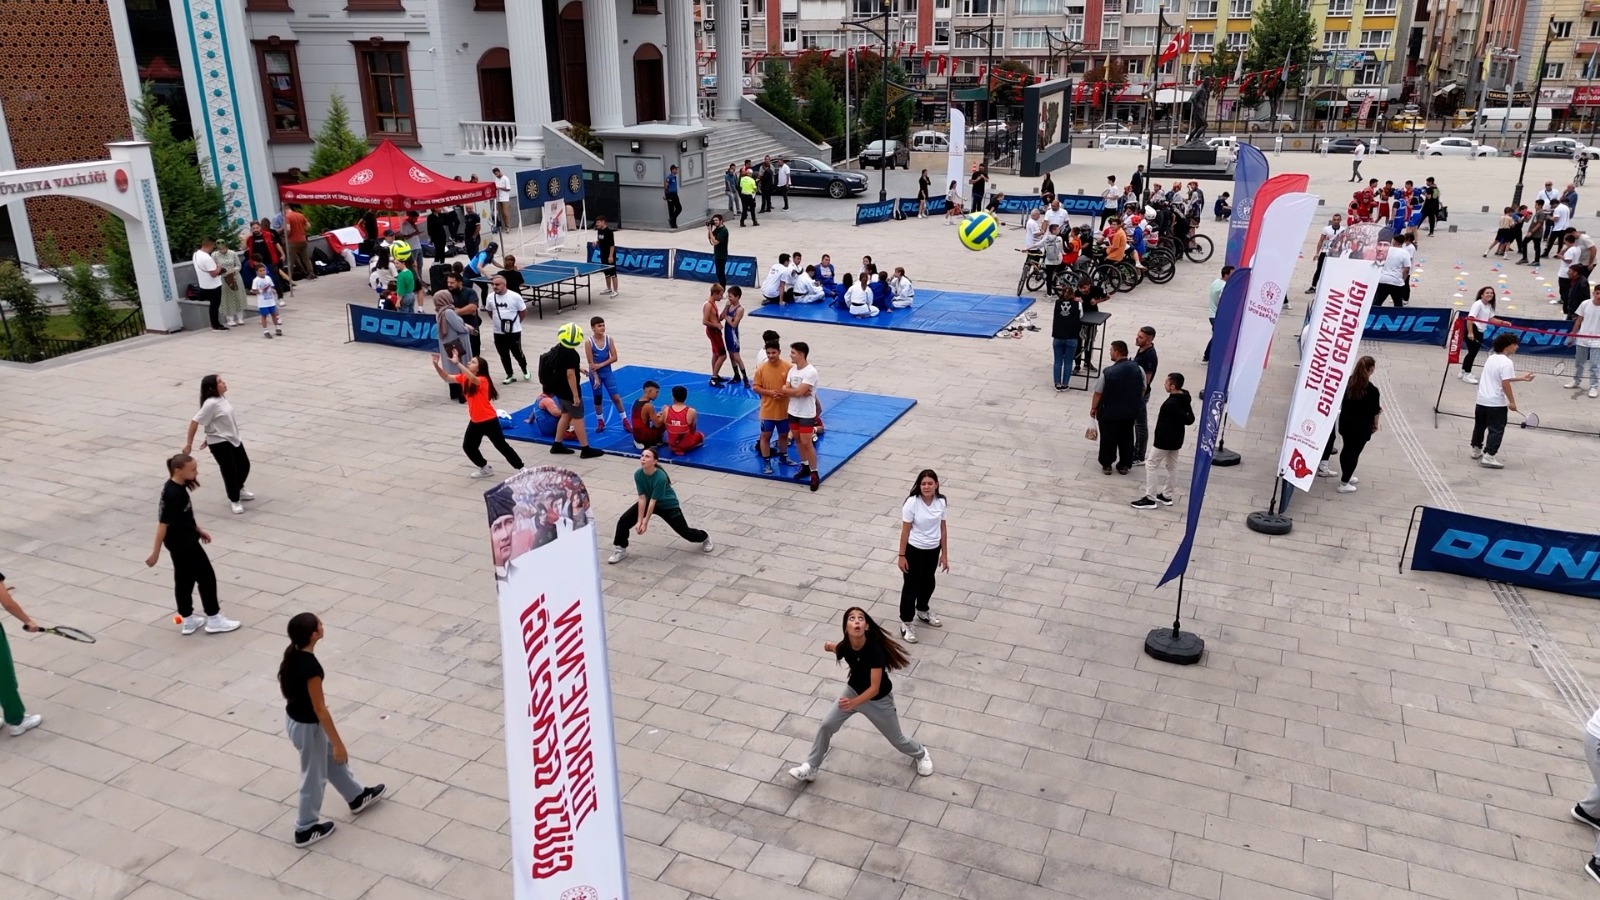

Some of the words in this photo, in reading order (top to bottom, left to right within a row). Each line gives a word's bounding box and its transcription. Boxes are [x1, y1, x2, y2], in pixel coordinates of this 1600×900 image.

[1353, 90, 1370, 98] dek
[0, 180, 52, 195] ÜTAHYA
[53, 170, 108, 188] VALİLİĞİ
[858, 203, 894, 219] DONIC
[591, 249, 664, 269] DNIC
[679, 257, 752, 277] DOIC
[1364, 314, 1440, 332] NIC
[1304, 288, 1345, 391] TÜRKİYE'NİN
[1317, 365, 1344, 417] GÜCÜ
[1331, 280, 1369, 365] GENÇLİĞİ
[1431, 528, 1600, 581] DON
